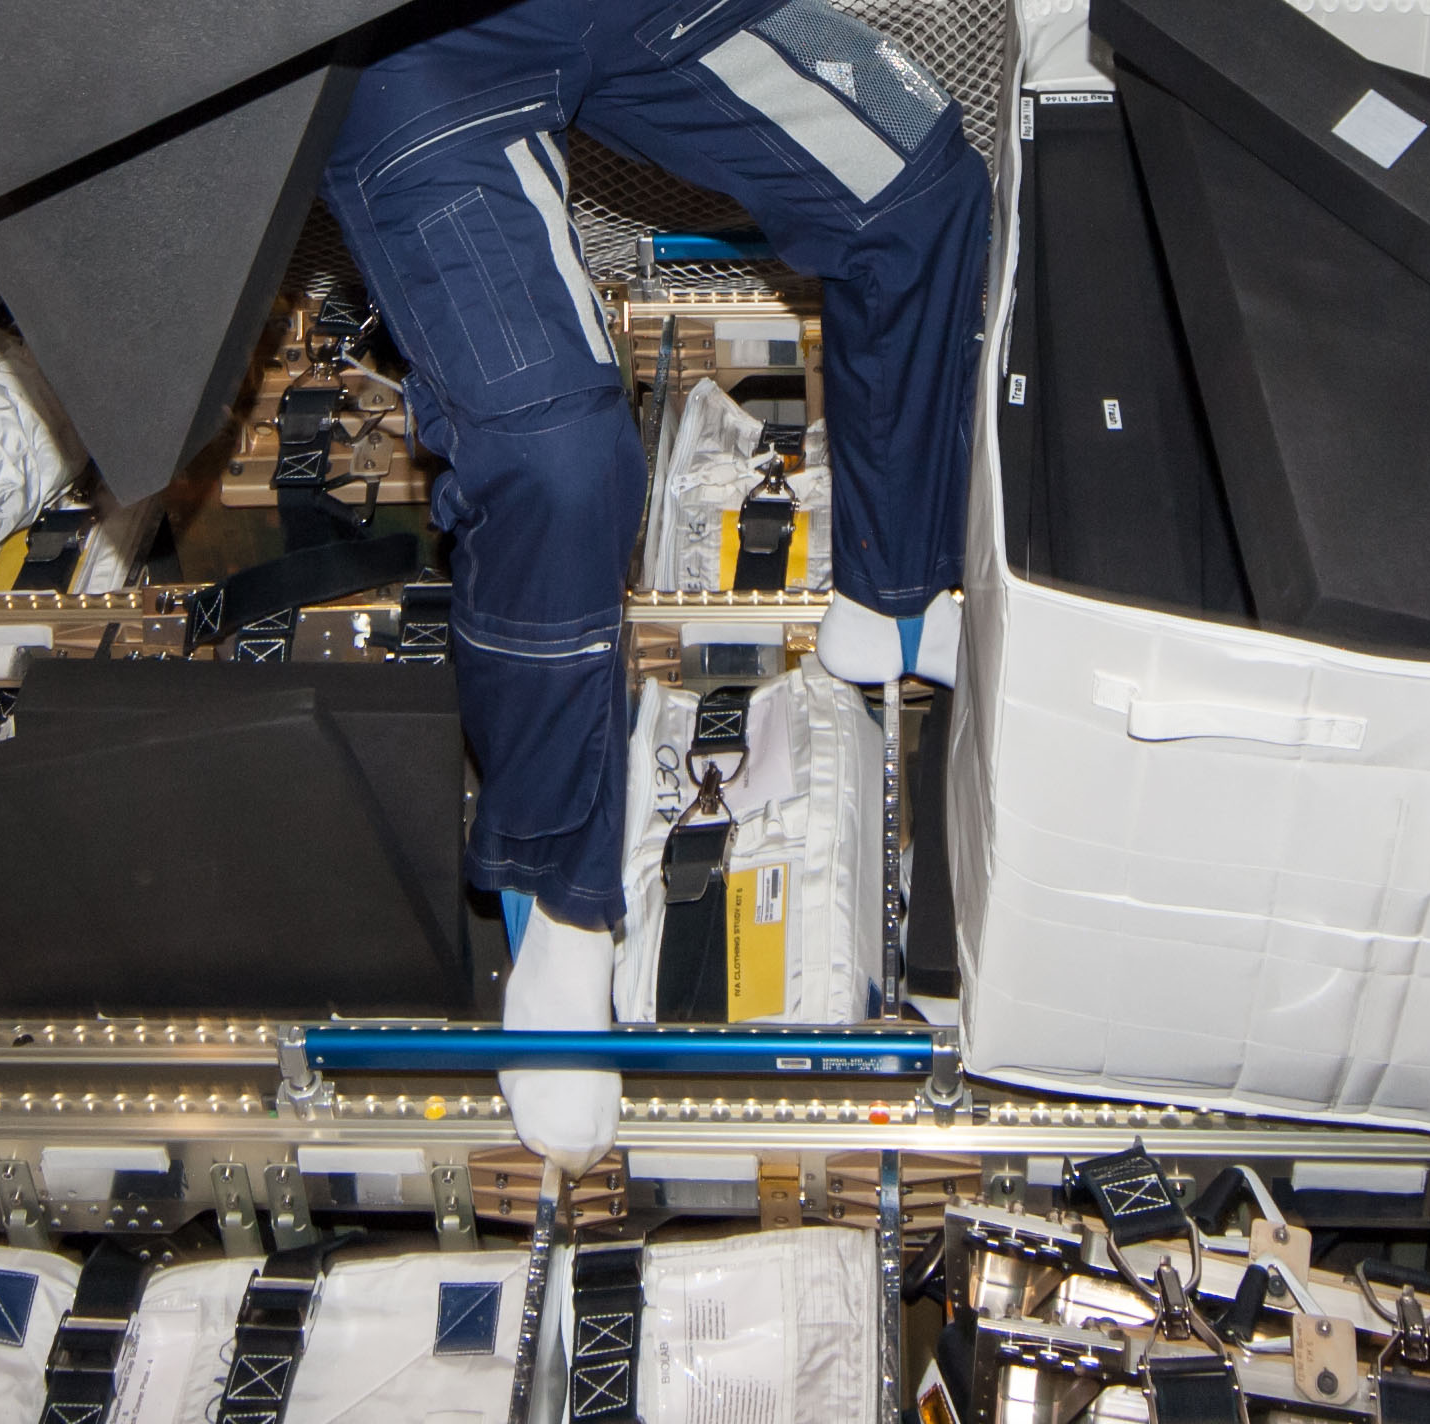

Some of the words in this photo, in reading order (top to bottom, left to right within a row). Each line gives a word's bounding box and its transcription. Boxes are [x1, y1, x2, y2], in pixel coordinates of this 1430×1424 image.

[1012, 378, 1023, 400] Trash
[1108, 403, 1118, 425] Trash
[655, 744, 681, 825] 4130
[734, 907, 742, 934] STUDY
[660, 1342, 670, 1384] BIOLAB
